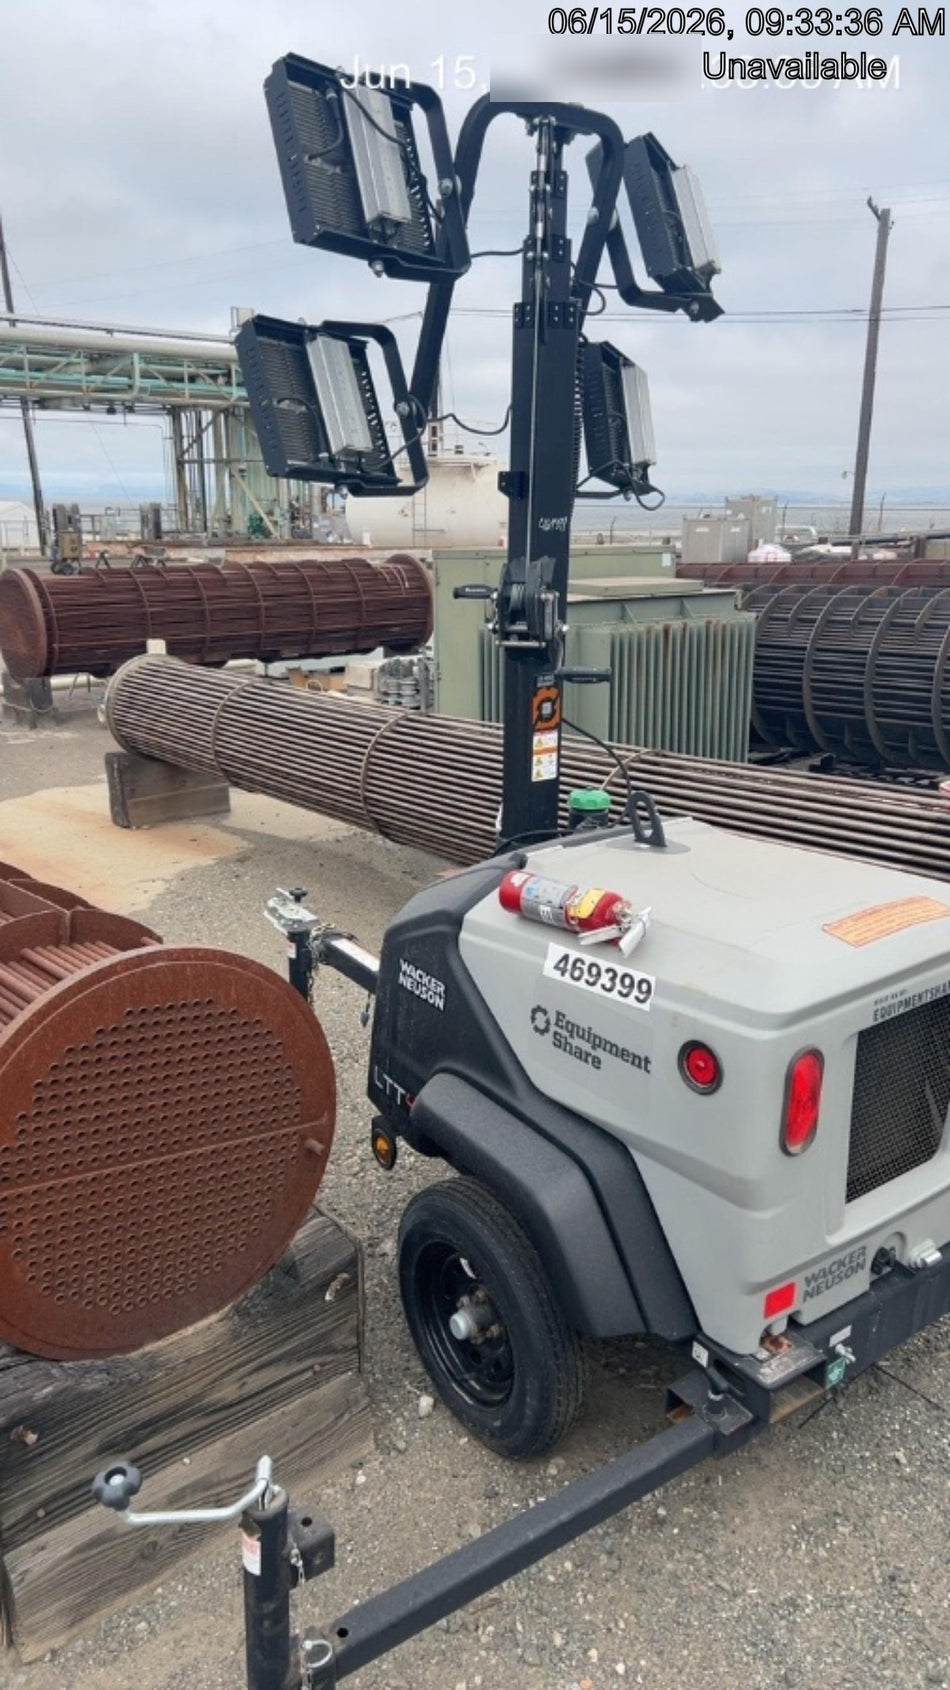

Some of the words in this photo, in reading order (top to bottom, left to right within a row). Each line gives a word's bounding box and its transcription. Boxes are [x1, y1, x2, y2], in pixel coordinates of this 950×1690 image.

[398, 972, 444, 1011] NEUSON
[399, 957, 445, 998] WACKER
[553, 953, 653, 1005] 469399
[552, 1031, 603, 1070] Share
[553, 1010, 652, 1075] Equipment
[803, 1257, 866, 1303] NEUSON
[804, 1245, 867, 1287] WACKER
